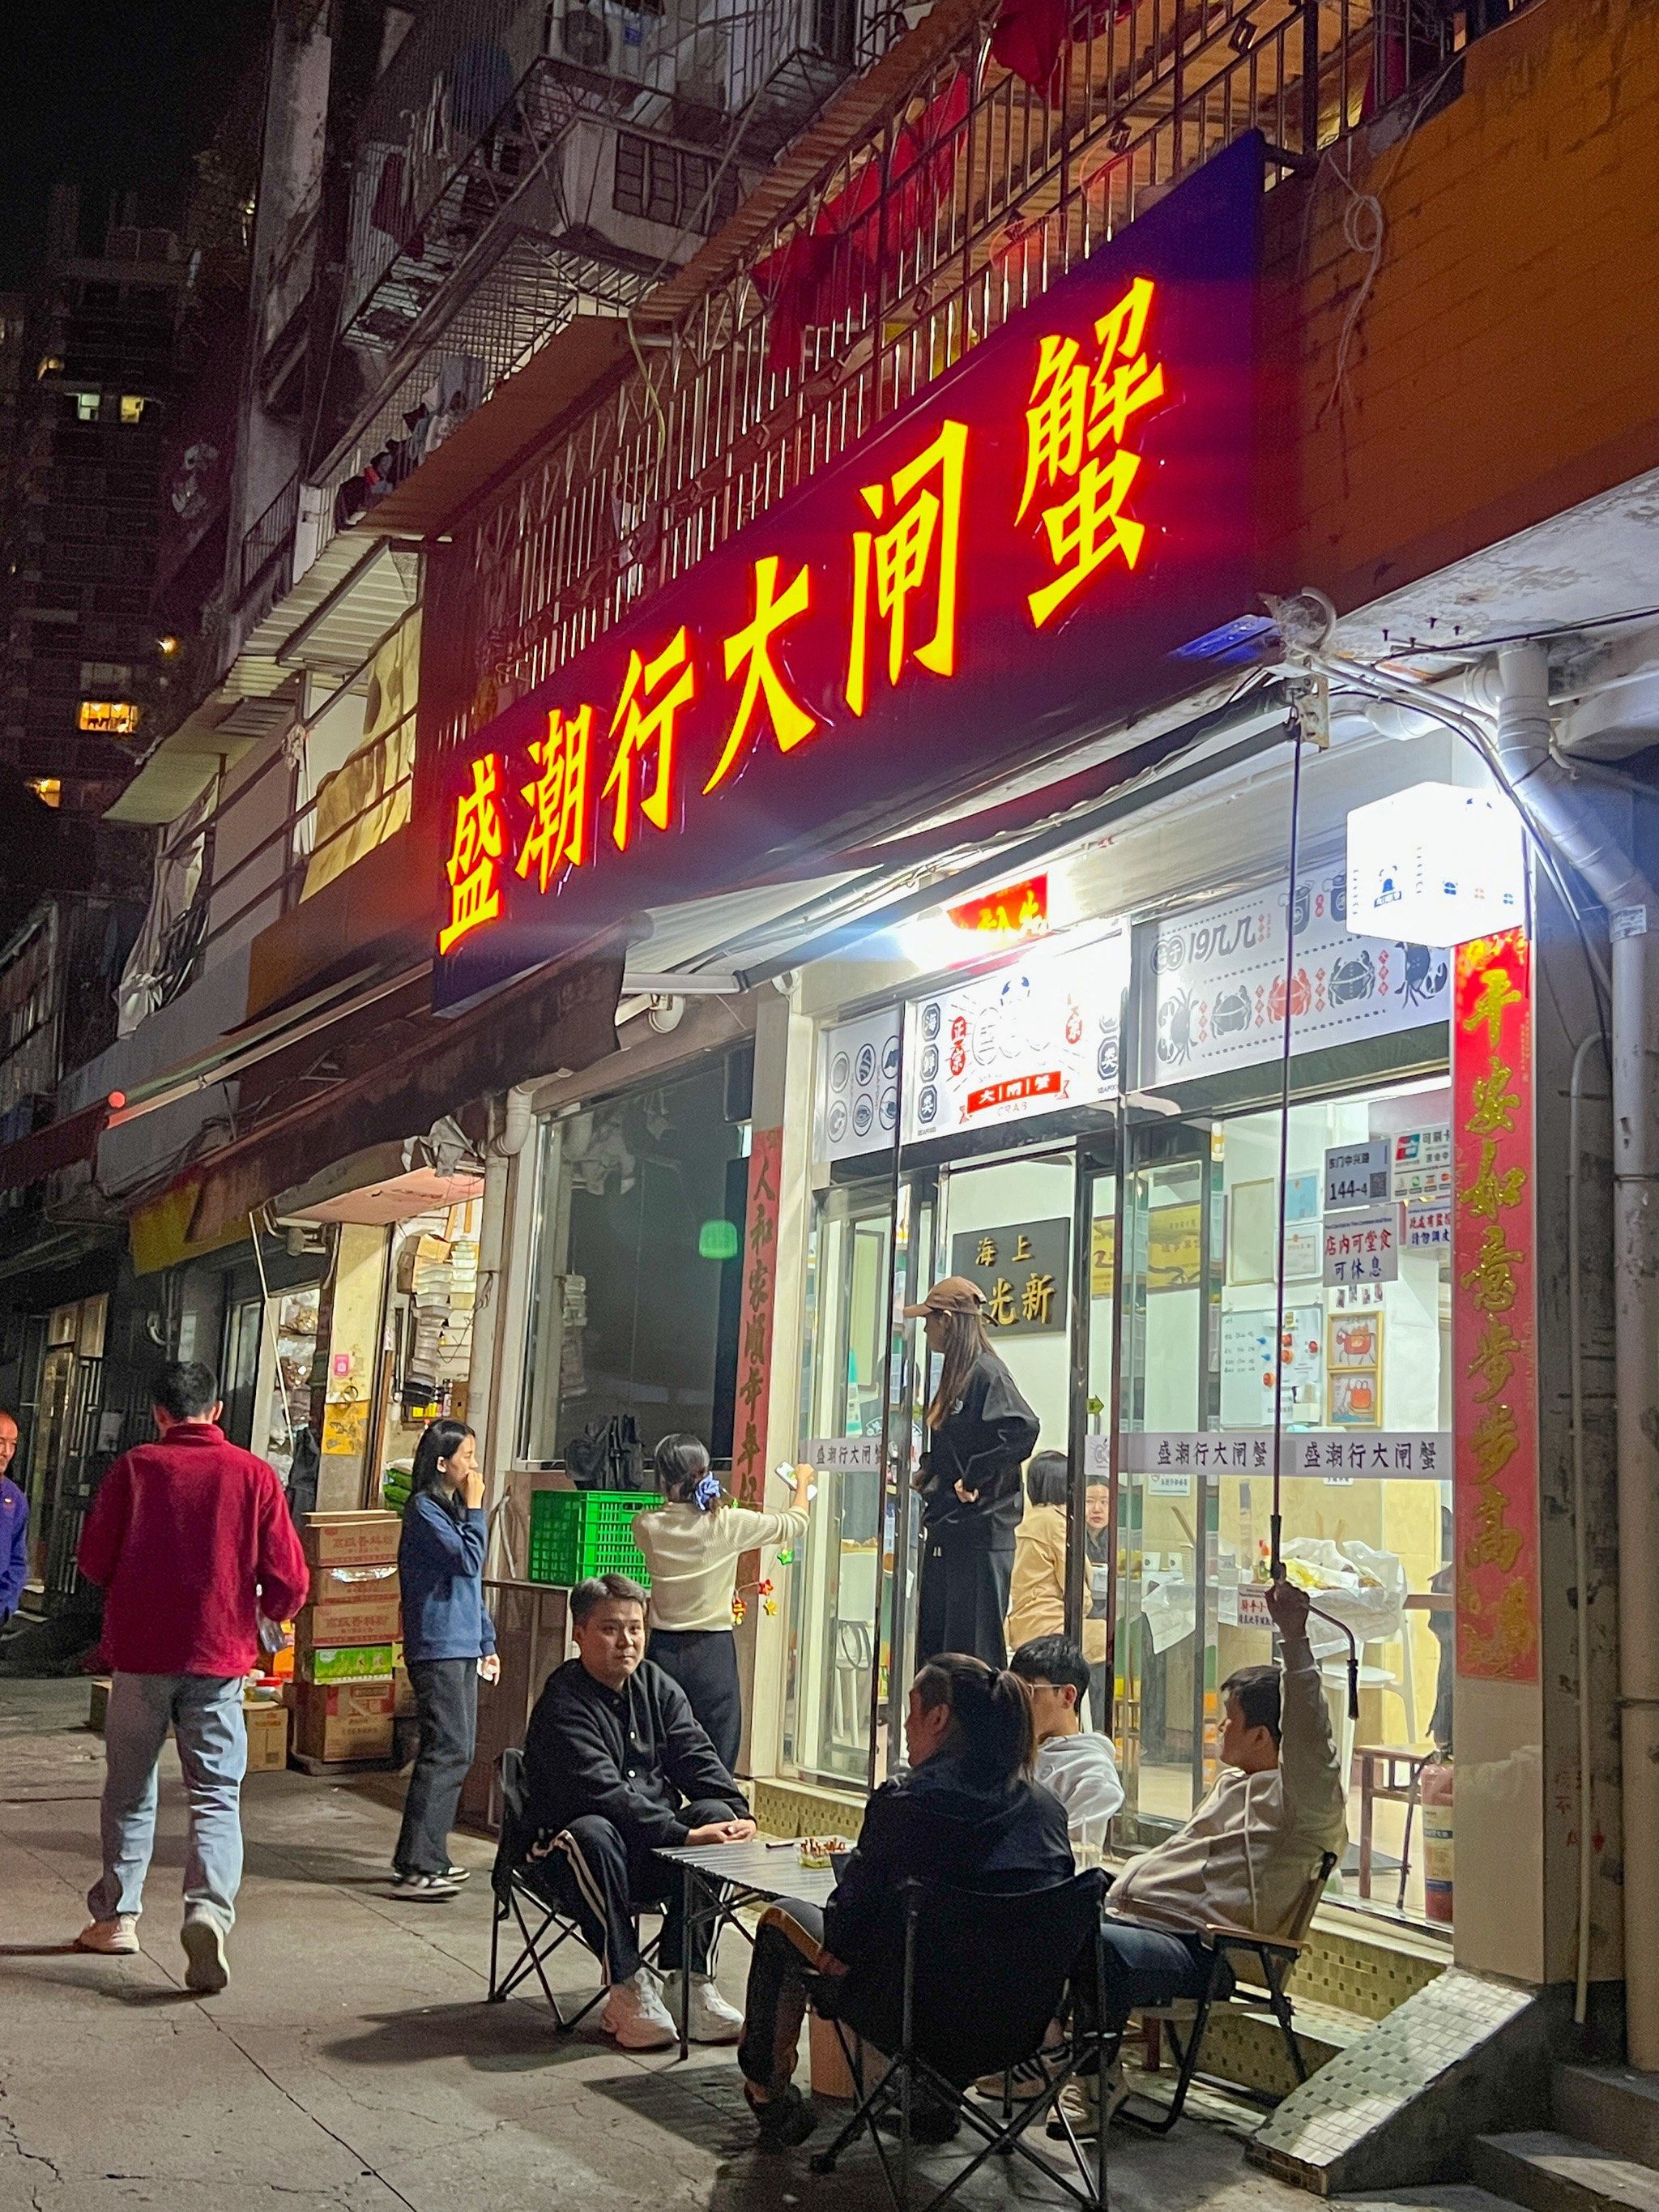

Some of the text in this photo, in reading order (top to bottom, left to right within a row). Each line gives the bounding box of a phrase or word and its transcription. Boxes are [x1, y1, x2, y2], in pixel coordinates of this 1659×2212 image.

[437, 275, 1165, 957] 盛潮行大闸蟹
[1330, 1180, 1367, 1201] 144-4
[1325, 1228, 1392, 1256] 店内可堂食
[1333, 1255, 1382, 1281] 可休息
[1157, 1440, 1268, 1467] 盛潮行大闸蟹
[1303, 1441, 1437, 1471] 盛潮行大闸蟹
